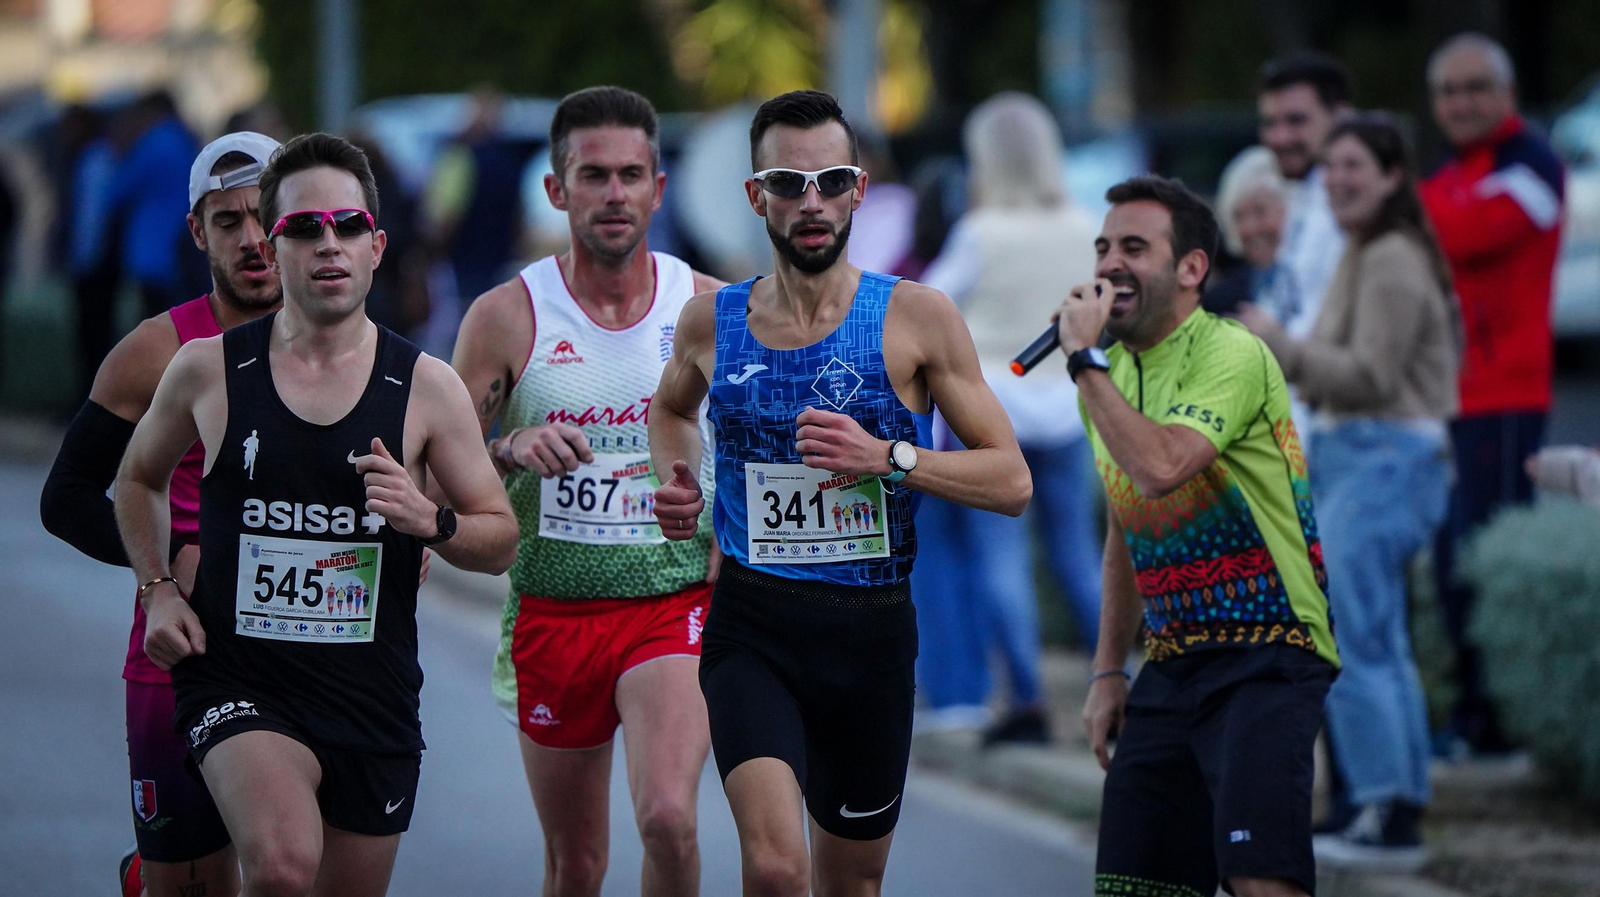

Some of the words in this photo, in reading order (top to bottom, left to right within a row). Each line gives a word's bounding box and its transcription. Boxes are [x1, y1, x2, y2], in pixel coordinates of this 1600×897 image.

[545, 393, 655, 427] marat
[556, 475, 620, 513] 567
[762, 490, 826, 530] 341
[315, 554, 358, 570] MARATÓN
[254, 564, 324, 608] 545
